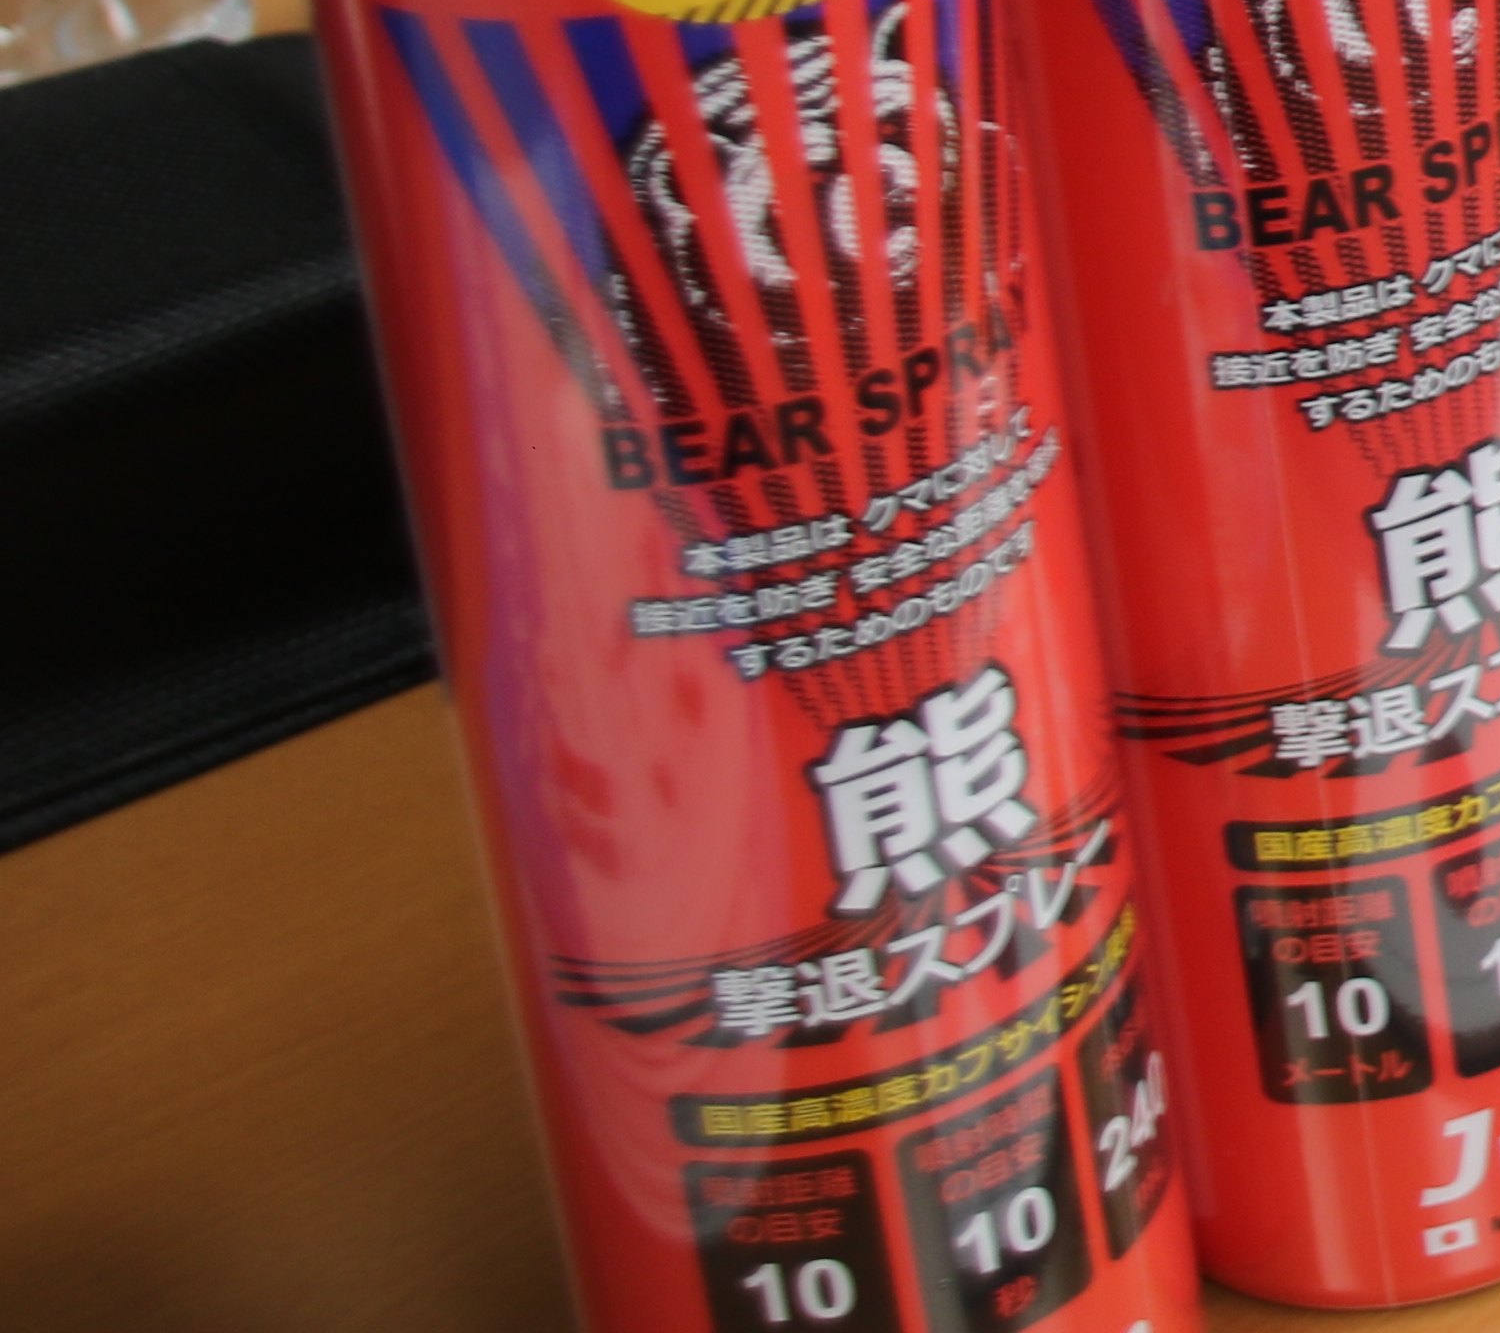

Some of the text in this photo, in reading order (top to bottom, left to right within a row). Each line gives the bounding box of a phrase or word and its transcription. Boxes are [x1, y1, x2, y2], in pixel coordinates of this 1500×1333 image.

[1192, 164, 1399, 250] BEAR
[1263, 273, 1415, 331] 本製品は
[1211, 327, 1401, 387] 接近を防ぎ
[603, 396, 834, 490] BEAR
[685, 406, 1033, 576] 本製品は クマに対して
[633, 570, 840, 635] 接近を防ぎ
[730, 519, 1036, 679] するためのものです
[813, 668, 1038, 912] 熊
[712, 818, 1110, 1035] 撃退スプレー
[1272, 932, 1380, 963] の目安
[1286, 977, 1390, 1039] 10
[1283, 1050, 1416, 1086] メートル
[941, 1133, 1046, 1203] の目安
[727, 1209, 842, 1244] の目安
[955, 1187, 1056, 1274] 10
[742, 1259, 858, 1324] 10
